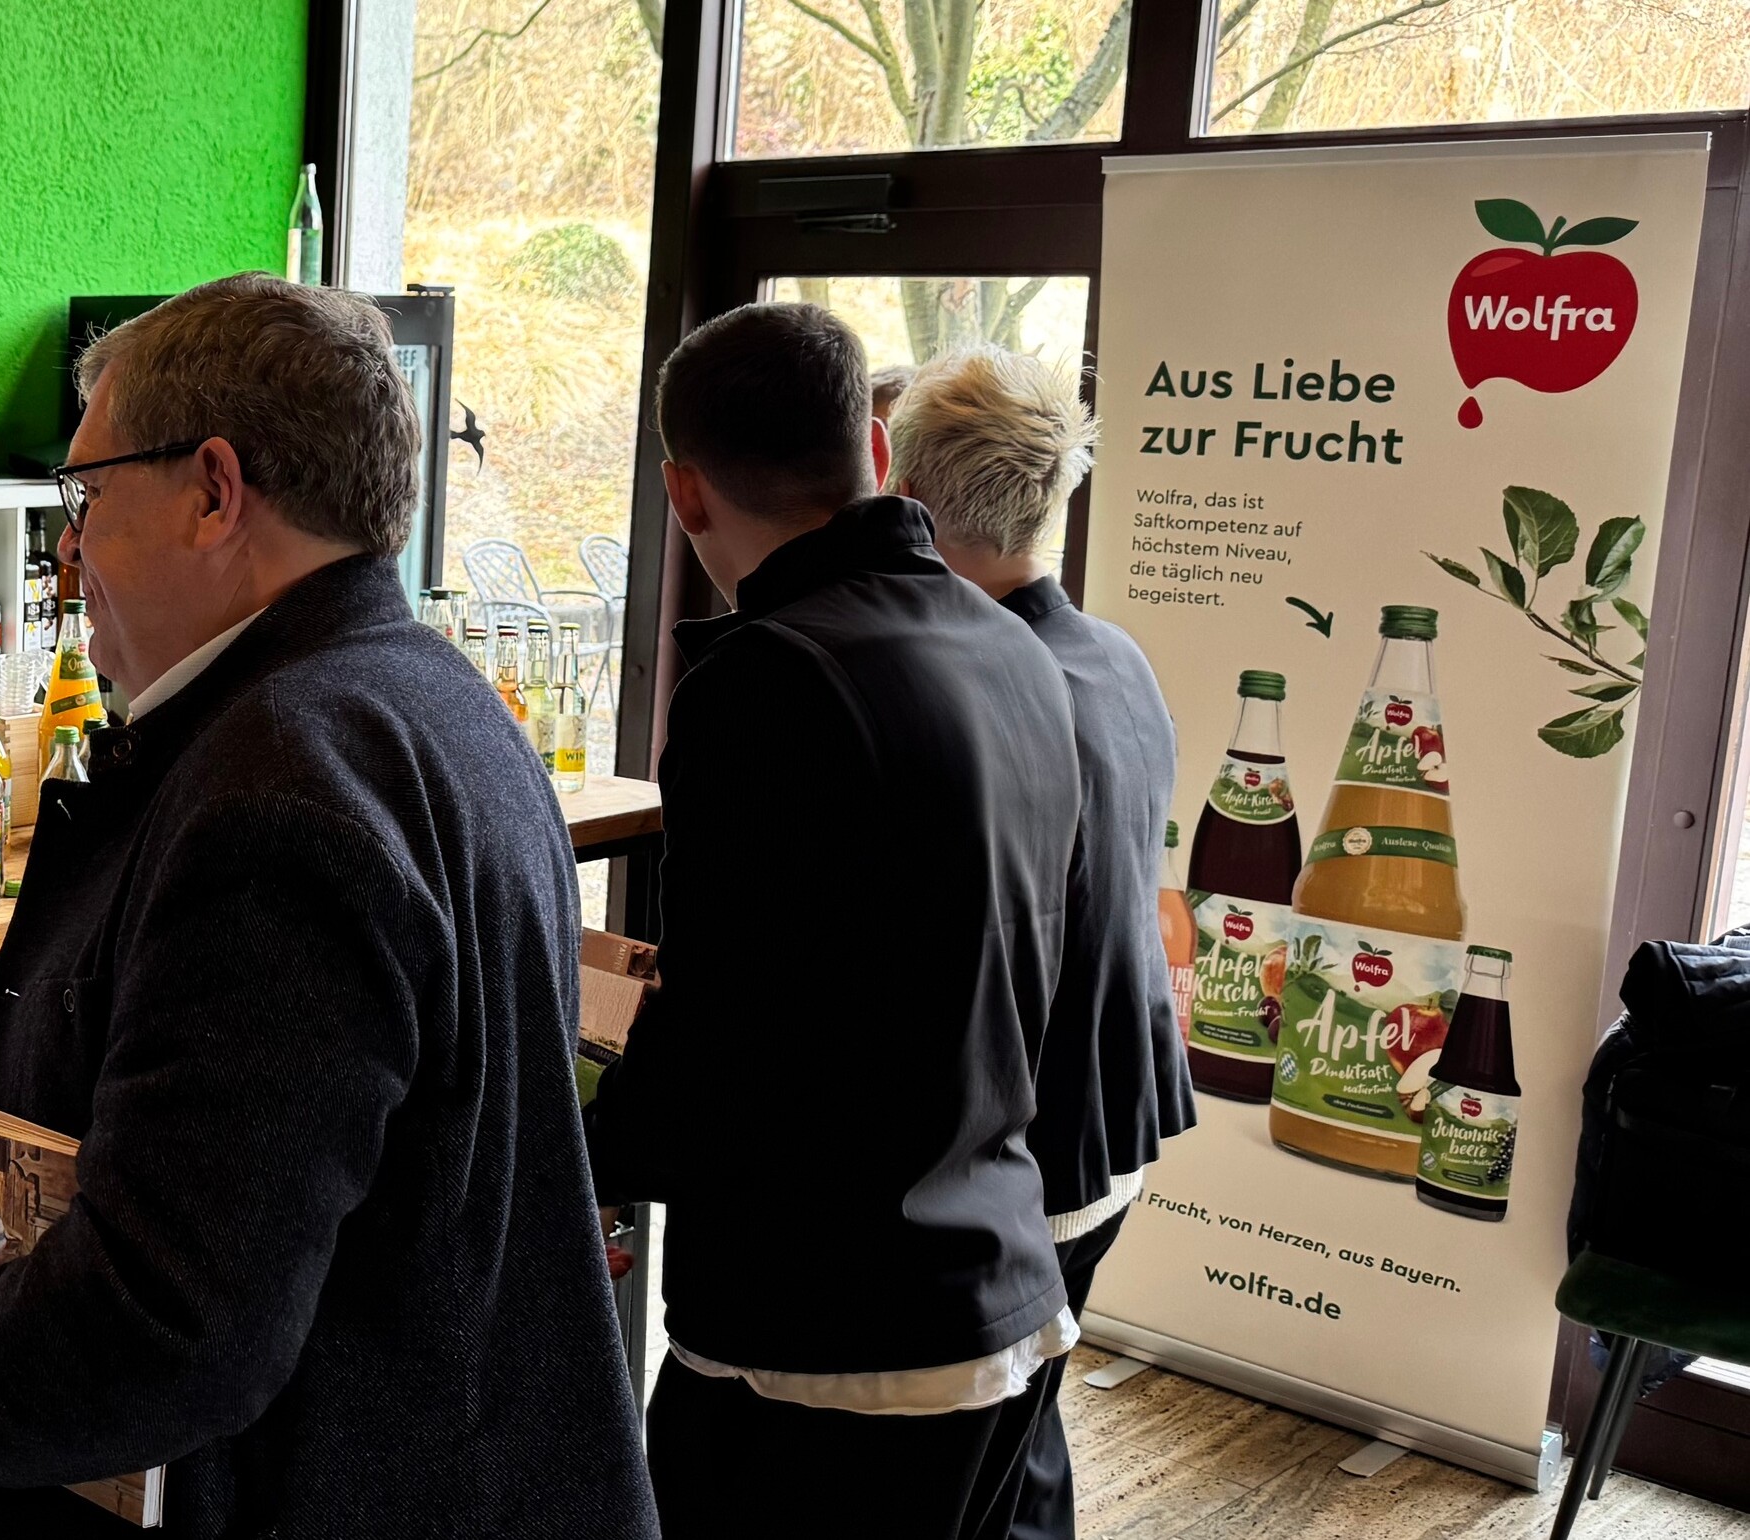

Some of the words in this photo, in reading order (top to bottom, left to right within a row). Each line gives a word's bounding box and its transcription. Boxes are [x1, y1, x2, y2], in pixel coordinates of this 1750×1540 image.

[1464, 294, 1616, 341] Wolfra
[1144, 360, 1233, 400] Aus
[1253, 358, 1396, 403] Liebe
[1139, 424, 1216, 456] zur
[1234, 420, 1404, 465] Frucht
[1137, 488, 1198, 510] Wolfra,
[1204, 491, 1237, 510] das
[1241, 492, 1264, 511] ist
[1133, 512, 1269, 538] Saftkompetenz
[1273, 518, 1302, 538] auf
[1131, 537, 1220, 557] höchstem
[1225, 544, 1292, 565] Niveau,
[1130, 560, 1155, 578] die
[1160, 561, 1224, 585] täglich
[1230, 569, 1263, 585] neu
[1128, 583, 1225, 608] begeistert.
[1386, 709, 1411, 719] Wolfra
[1355, 728, 1422, 765] Apfel
[1225, 921, 1251, 933] Wolfra
[1195, 939, 1263, 982] Apfel
[1355, 961, 1389, 976] Wolfra
[1192, 973, 1259, 1003] Kirsch
[1296, 989, 1416, 1062] Apfel
[1450, 1139, 1488, 1158] beere
[1148, 1192, 1212, 1225] Frucht,
[1218, 1214, 1253, 1233] von
[1258, 1222, 1331, 1259] Herzen,
[1338, 1248, 1375, 1269] aus
[1380, 1254, 1461, 1293] Bayern.
[1204, 1265, 1342, 1321] wolfra.de
